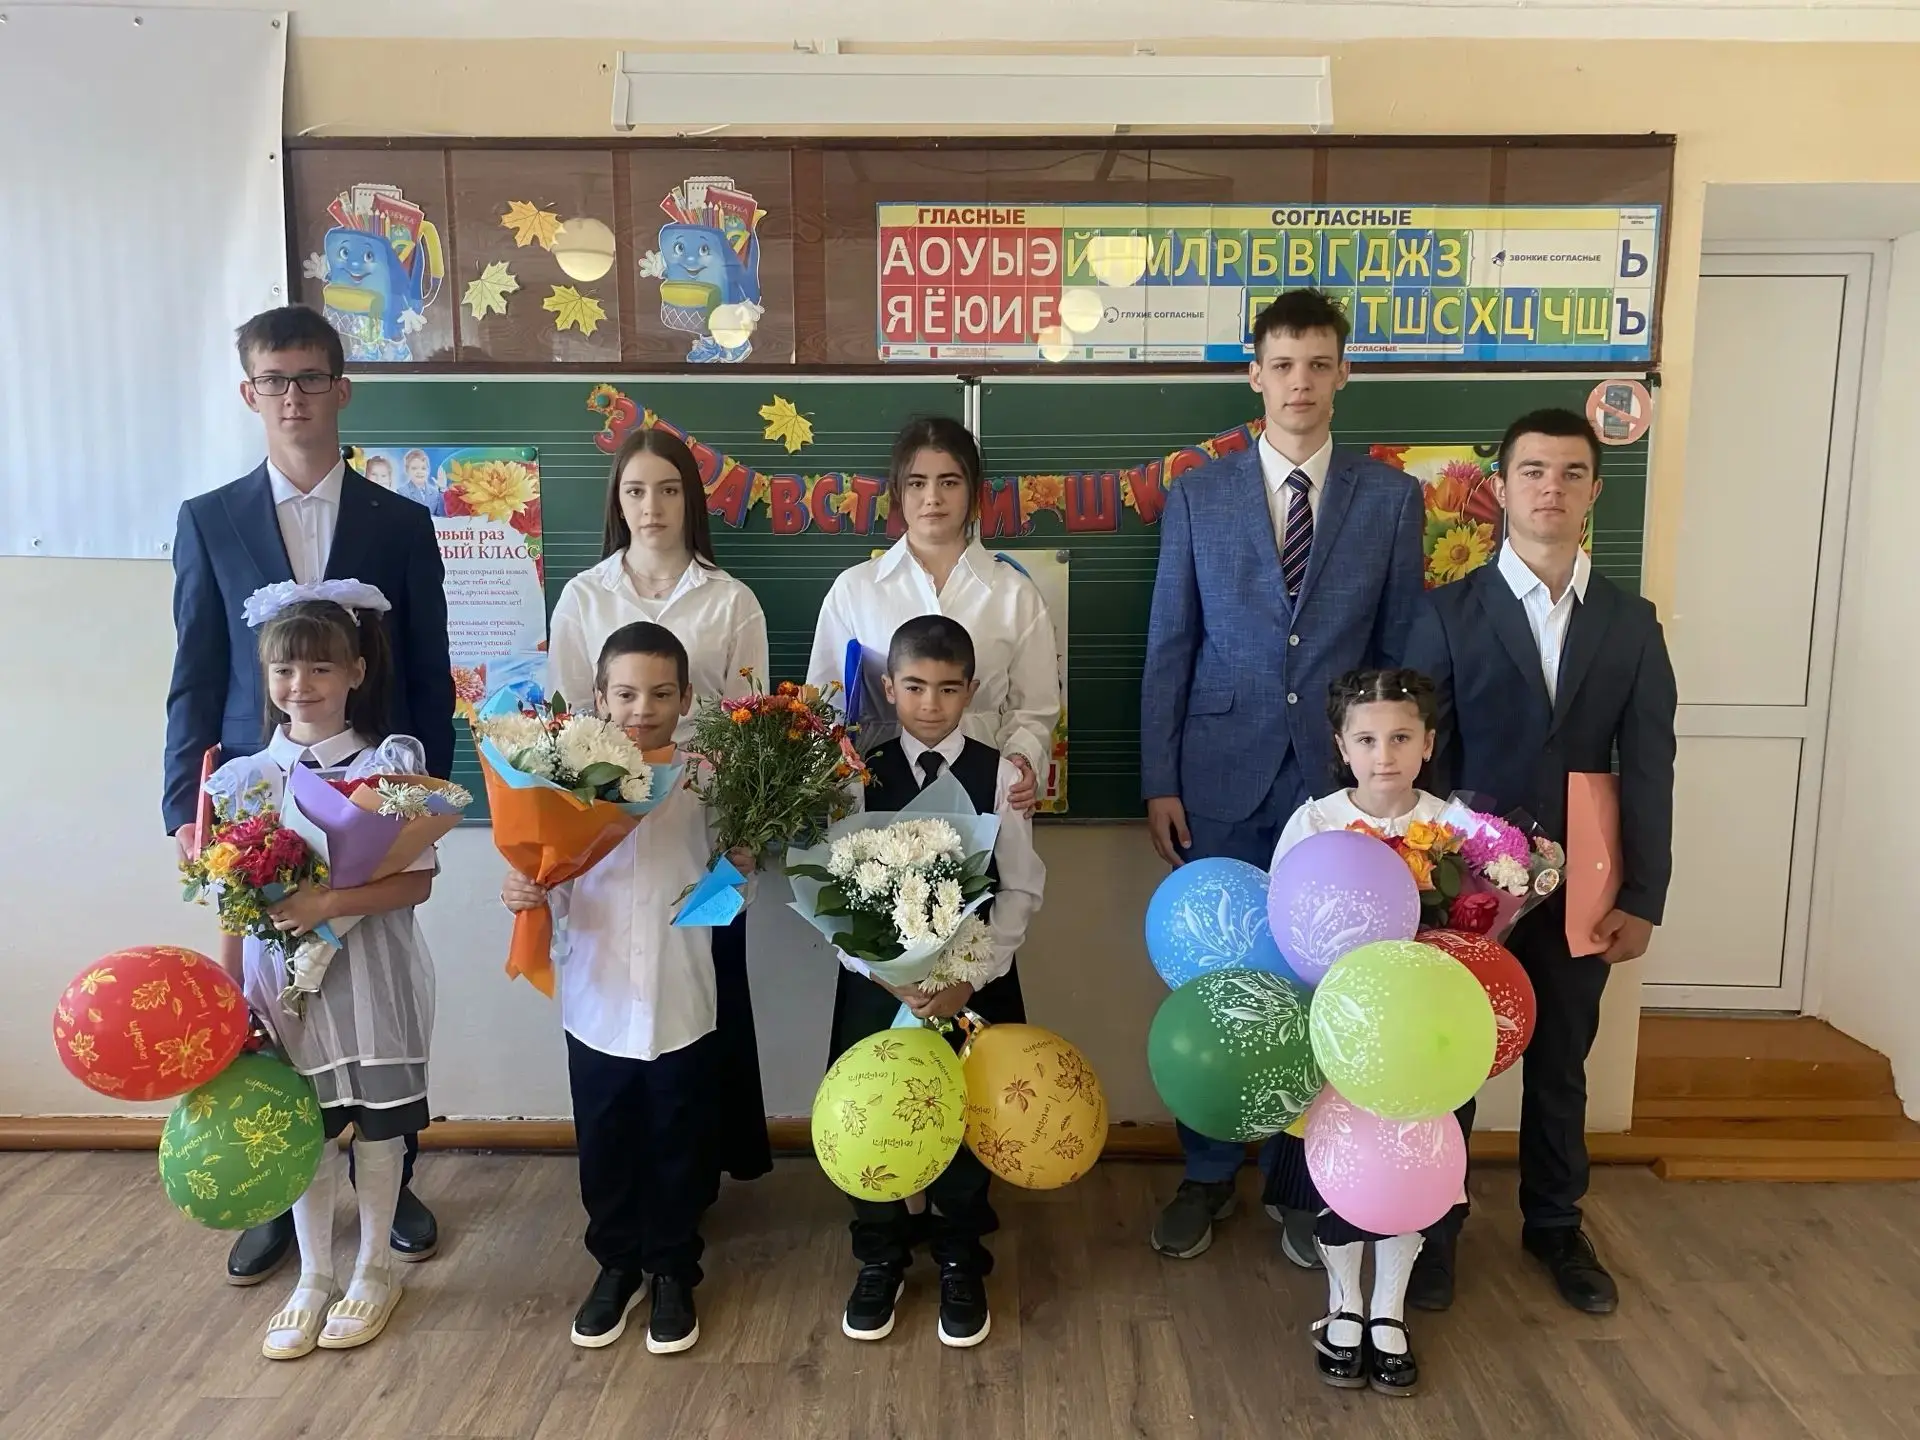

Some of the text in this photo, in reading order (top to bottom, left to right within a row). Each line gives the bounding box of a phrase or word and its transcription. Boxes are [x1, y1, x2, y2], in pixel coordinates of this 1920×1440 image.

[918, 208, 1026, 225] ГЛАСНЫЕ
[1271, 209, 1412, 226] СОГЛАСНЫЕ
[1509, 254, 1602, 262] ЗВОНКИЕ СОГЛАСНЫЕ
[1120, 311, 1205, 319] ГЛУХИЕ СОГЛАСНЫЕ
[479, 530, 505, 544] раз
[478, 545, 541, 560] КЛАСС
